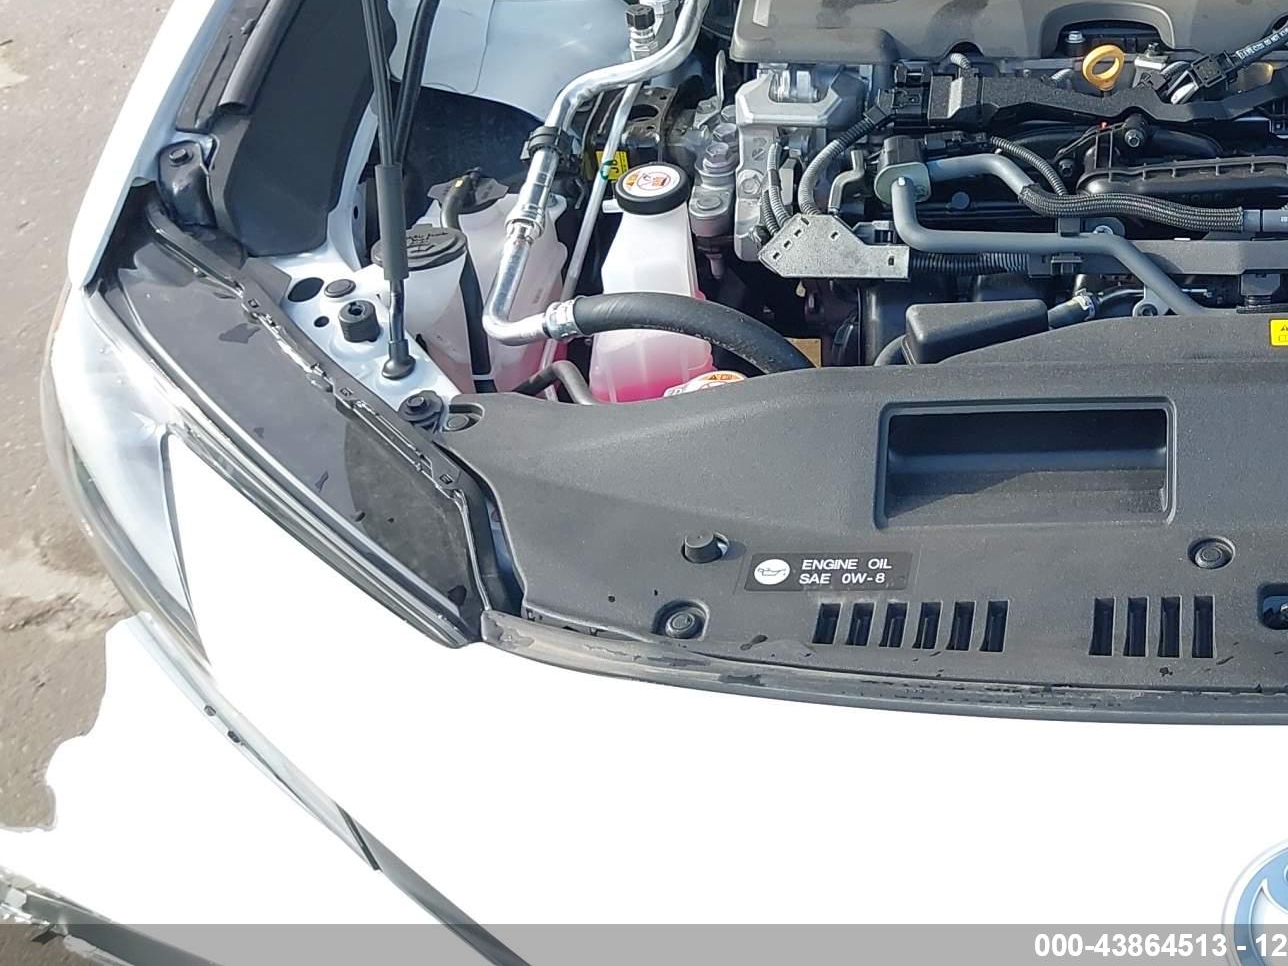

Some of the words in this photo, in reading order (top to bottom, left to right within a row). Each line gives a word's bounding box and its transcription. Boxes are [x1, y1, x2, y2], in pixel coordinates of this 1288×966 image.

[801, 558, 859, 571] ENGINE
[867, 558, 893, 570] OIL
[798, 572, 832, 585] SAE
[841, 572, 886, 584] 0W-8
